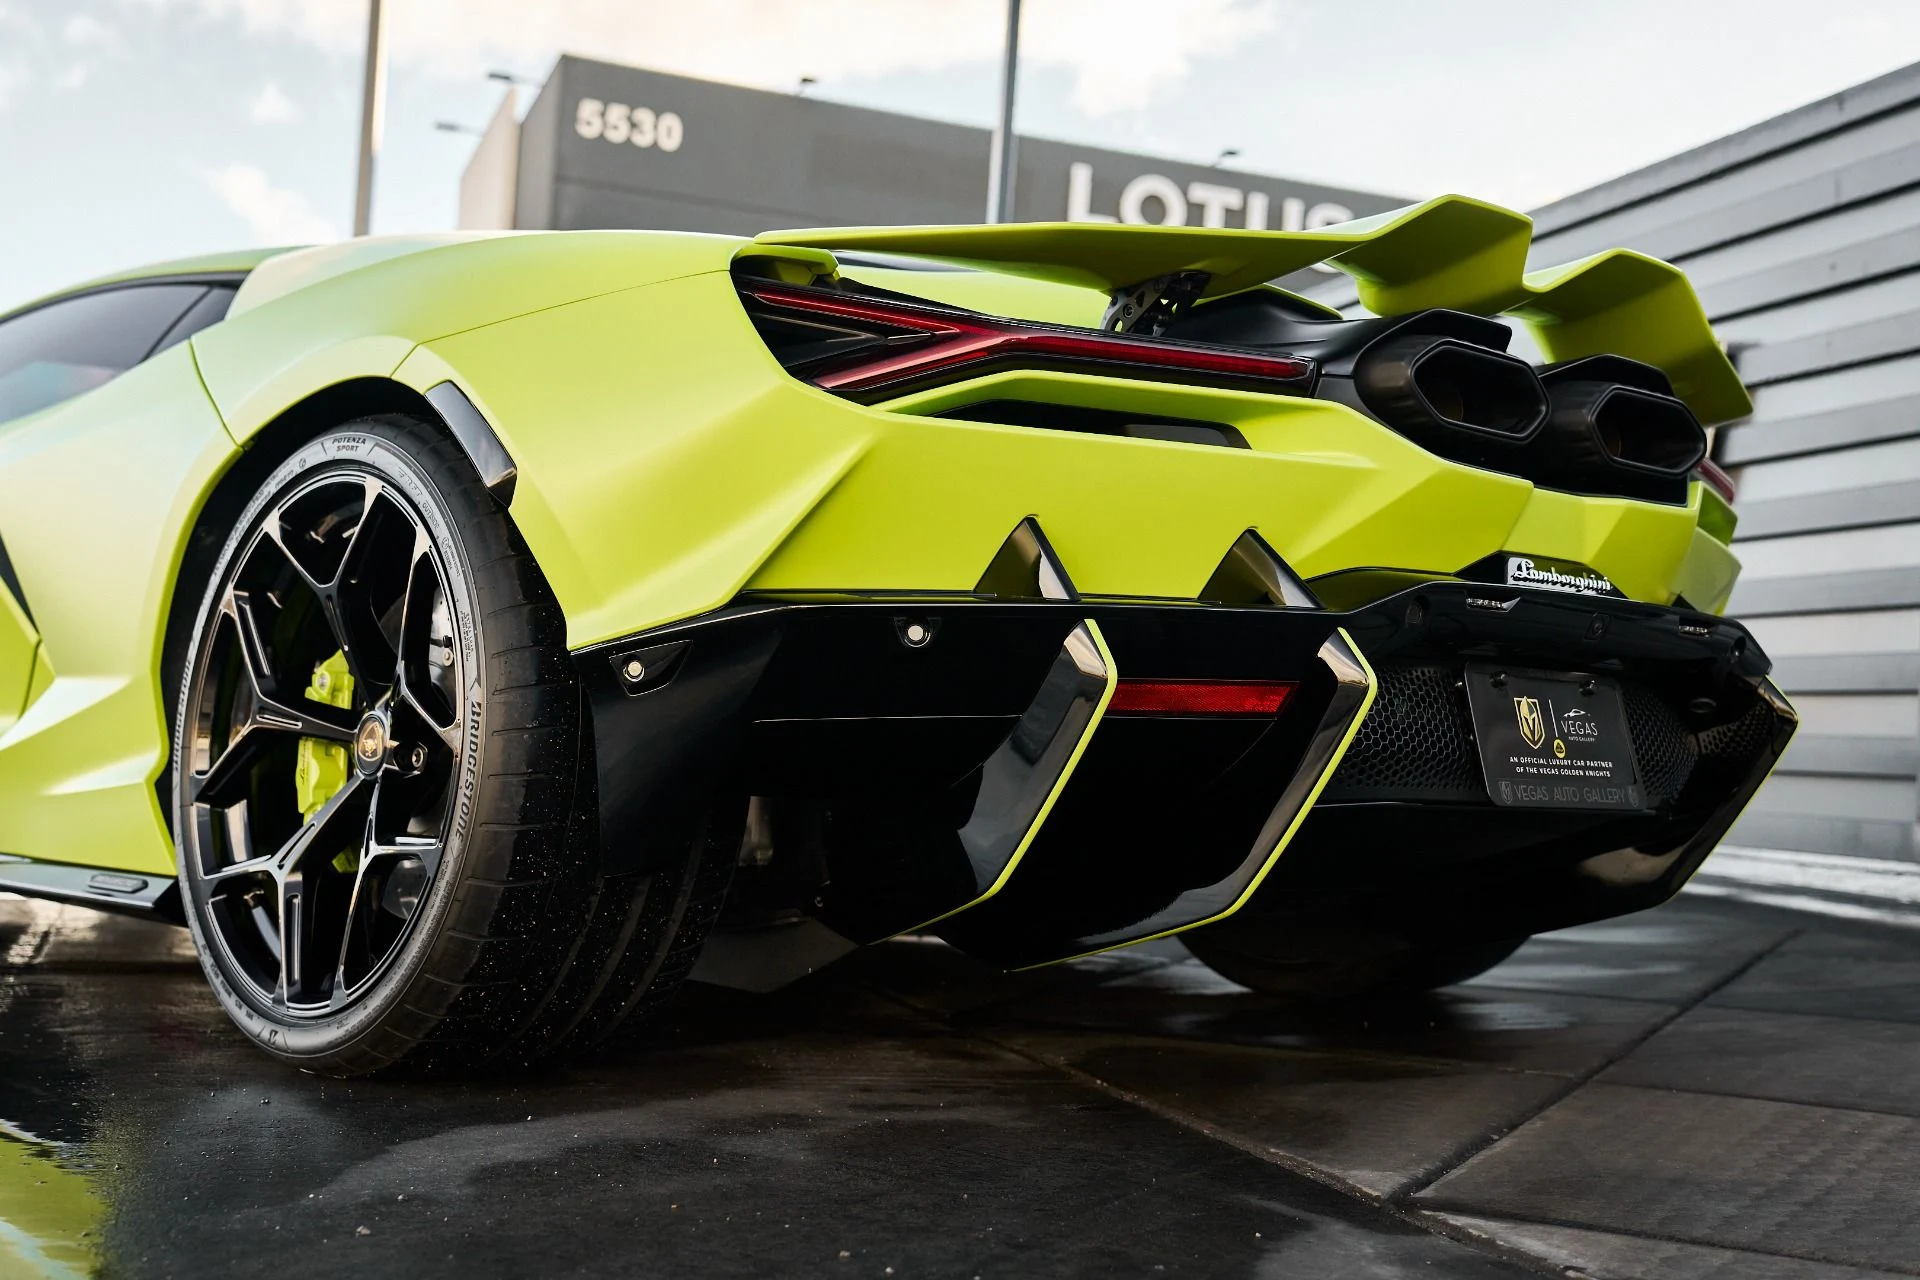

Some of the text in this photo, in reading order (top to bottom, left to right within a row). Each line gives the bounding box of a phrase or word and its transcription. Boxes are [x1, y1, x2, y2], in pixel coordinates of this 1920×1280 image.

[574, 97, 684, 153] 5530
[332, 436, 367, 445] POTENZA
[1512, 559, 1612, 590] Lamborghini
[1560, 720, 1598, 736] VEGAS
[1520, 756, 1548, 765] OFFICIAL
[1548, 758, 1571, 766] LUXURY
[1572, 759, 1585, 767] CAR
[1586, 760, 1613, 768] PARTNER
[455, 700, 482, 843] BRIDGESTONE
[1526, 766, 1538, 774] THE
[1539, 767, 1559, 775] VEGAS
[1560, 769, 1584, 777] GOLDEN
[1585, 770, 1611, 778] KNIGHTS
[1513, 784, 1625, 803] VEGAS AUTO GALLERY
